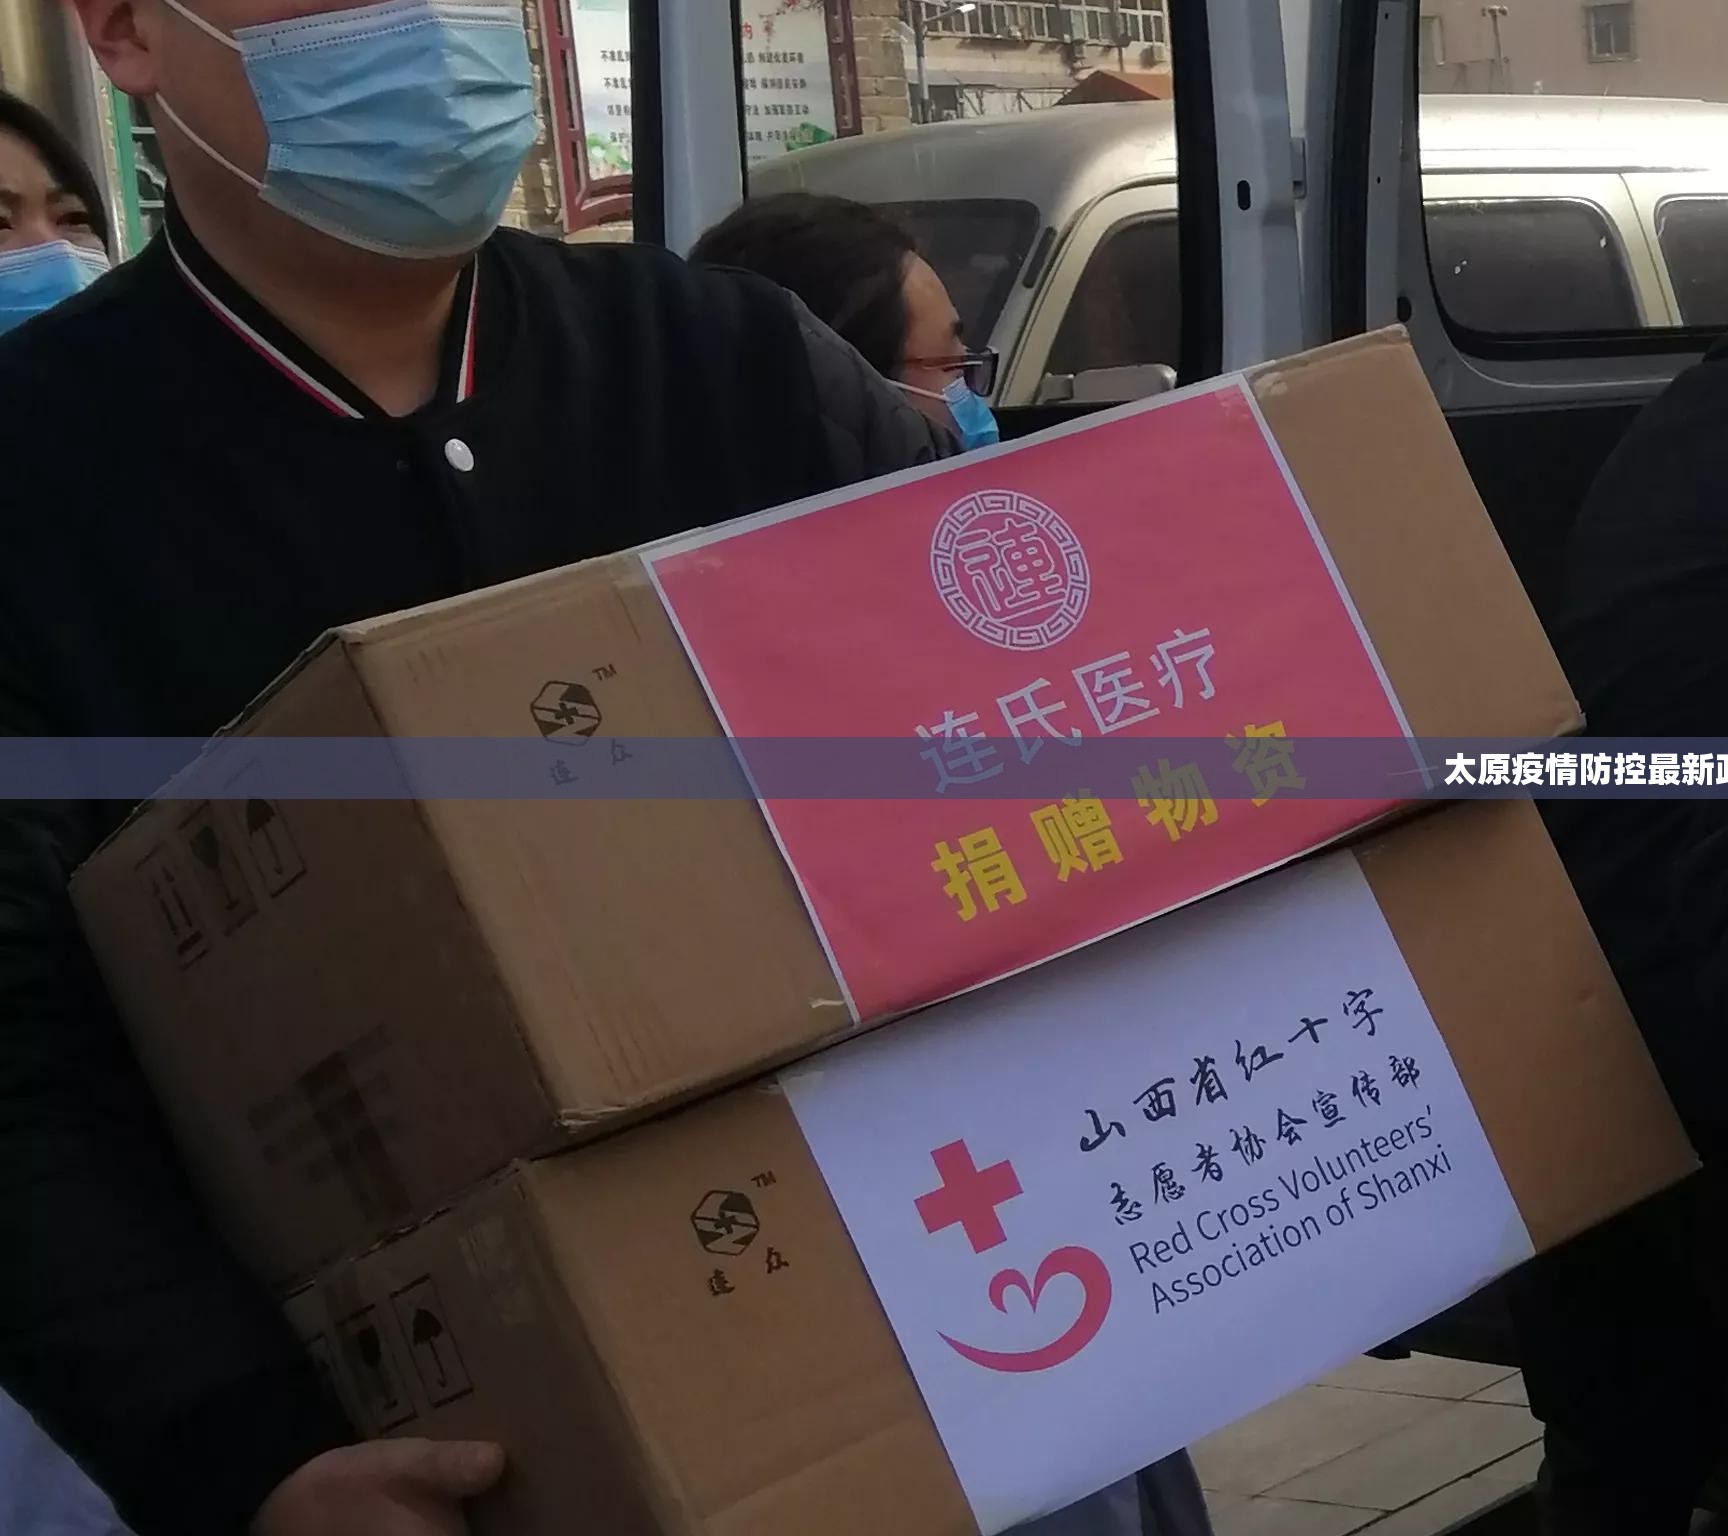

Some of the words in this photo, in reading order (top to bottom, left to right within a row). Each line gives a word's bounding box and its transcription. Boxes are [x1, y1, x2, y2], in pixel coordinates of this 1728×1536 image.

[913, 627, 1220, 794] 连氏医疗
[930, 720, 1308, 923] 捐赠物资
[1079, 987, 1385, 1155] 山西省红十字
[1109, 1056, 1422, 1227] 志愿者协会宣传部
[1129, 1222, 1193, 1275] Red
[1197, 1188, 1280, 1244] Cross
[1278, 1104, 1435, 1202] Volunteers'
[1150, 1207, 1321, 1314] Association
[1326, 1185, 1357, 1229] of
[1359, 1141, 1454, 1212] Shanxi
